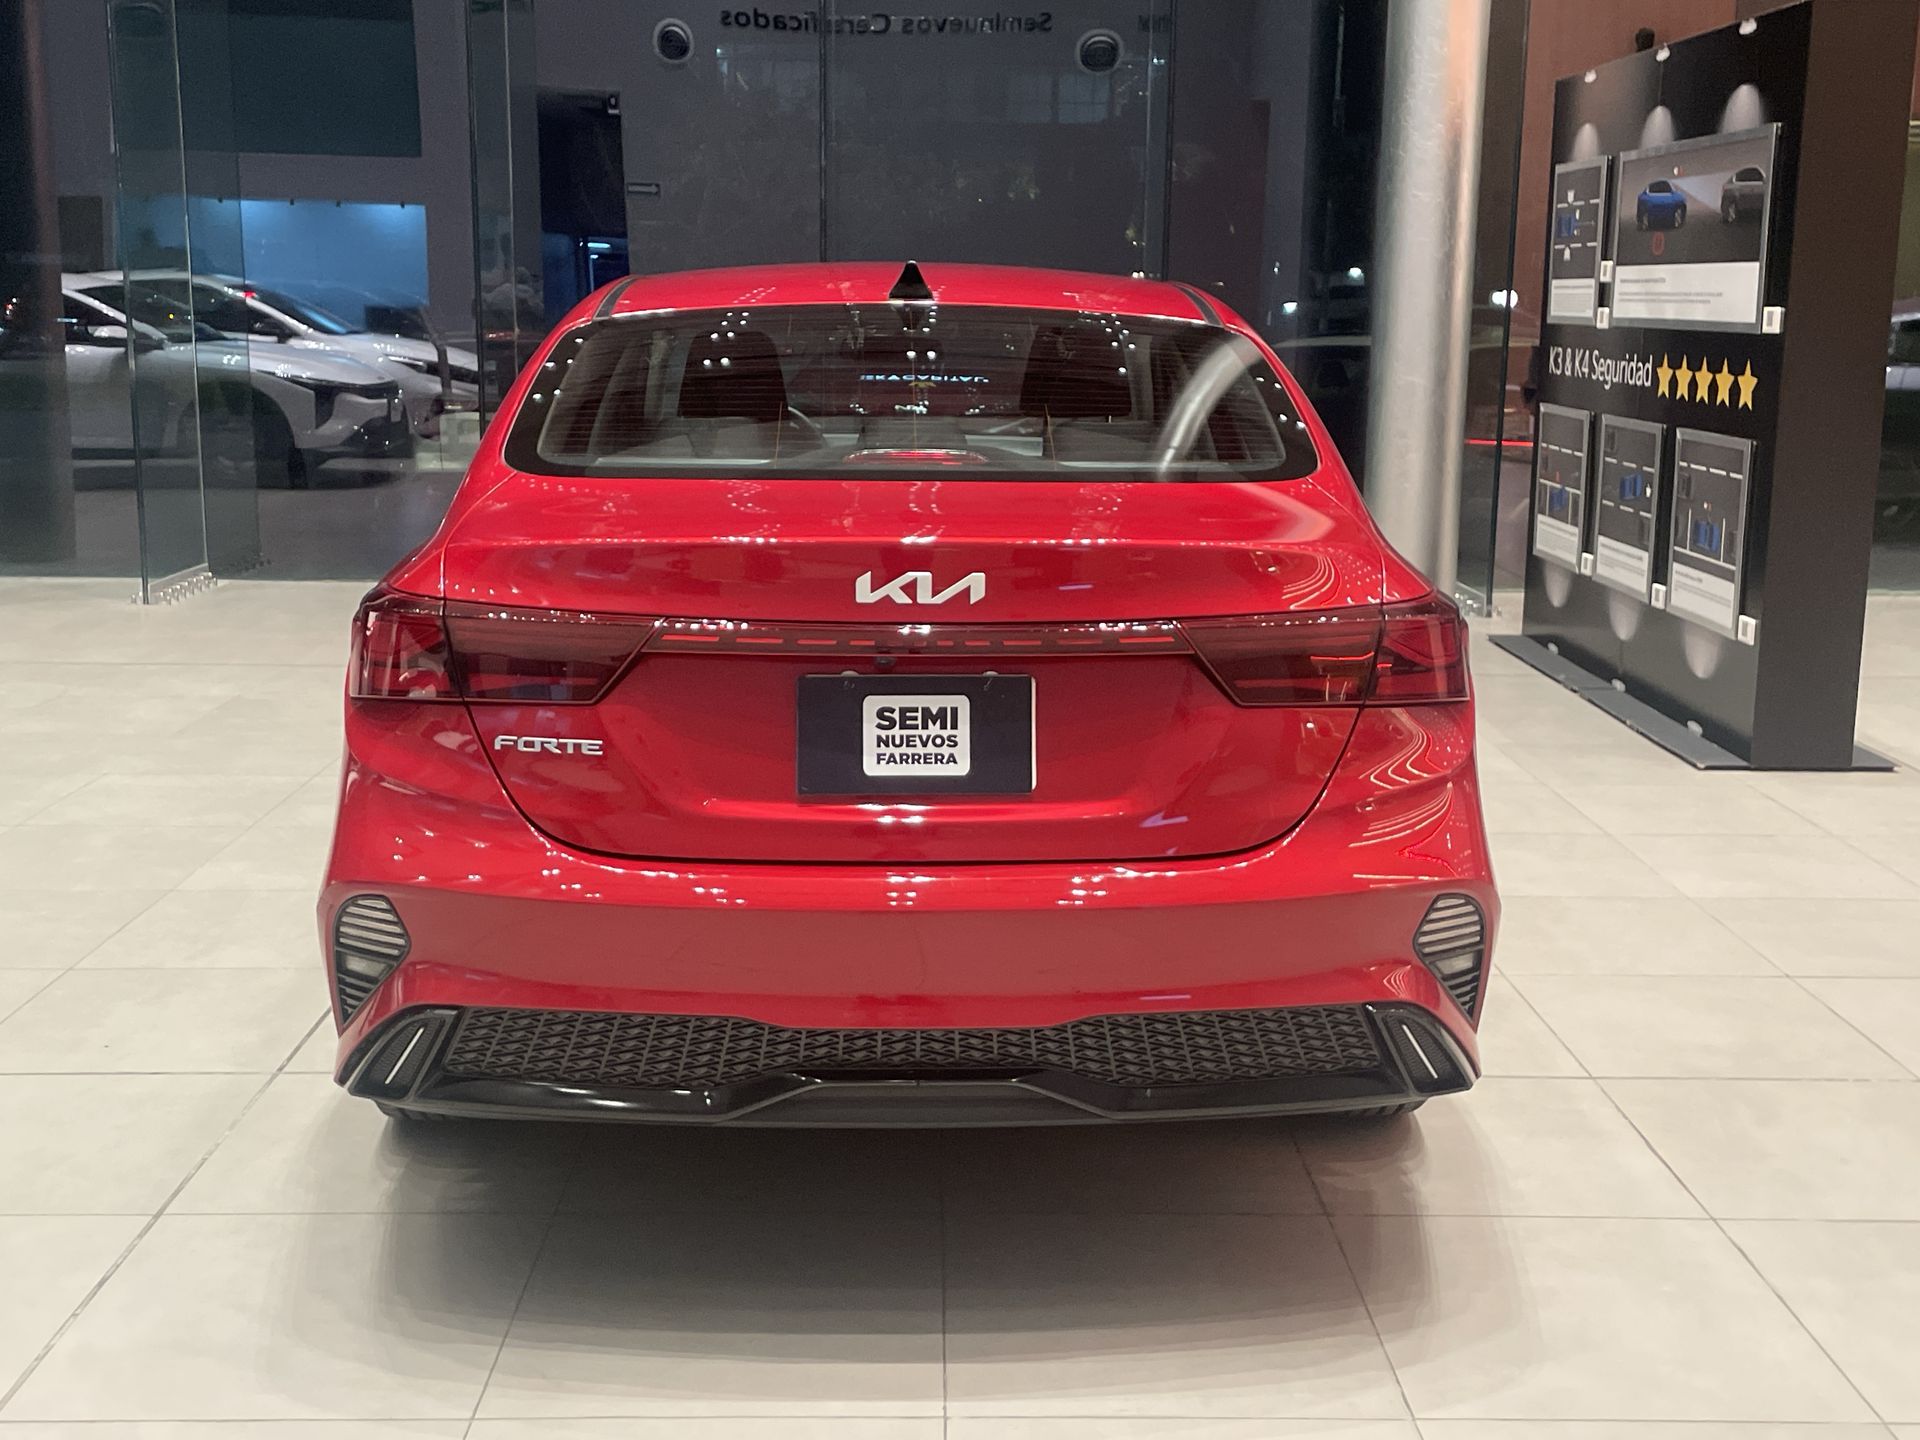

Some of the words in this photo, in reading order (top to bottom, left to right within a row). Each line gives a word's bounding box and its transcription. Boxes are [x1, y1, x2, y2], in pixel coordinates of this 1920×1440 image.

[1548, 346, 1562, 375] K3
[1565, 349, 1573, 376] &
[1575, 349, 1590, 378] K4
[1591, 351, 1653, 388] Seguridad
[875, 706, 959, 730] SEMI
[494, 735, 604, 756] FORTE
[876, 734, 959, 748] NUEVOS
[876, 752, 958, 765] FARRERA
